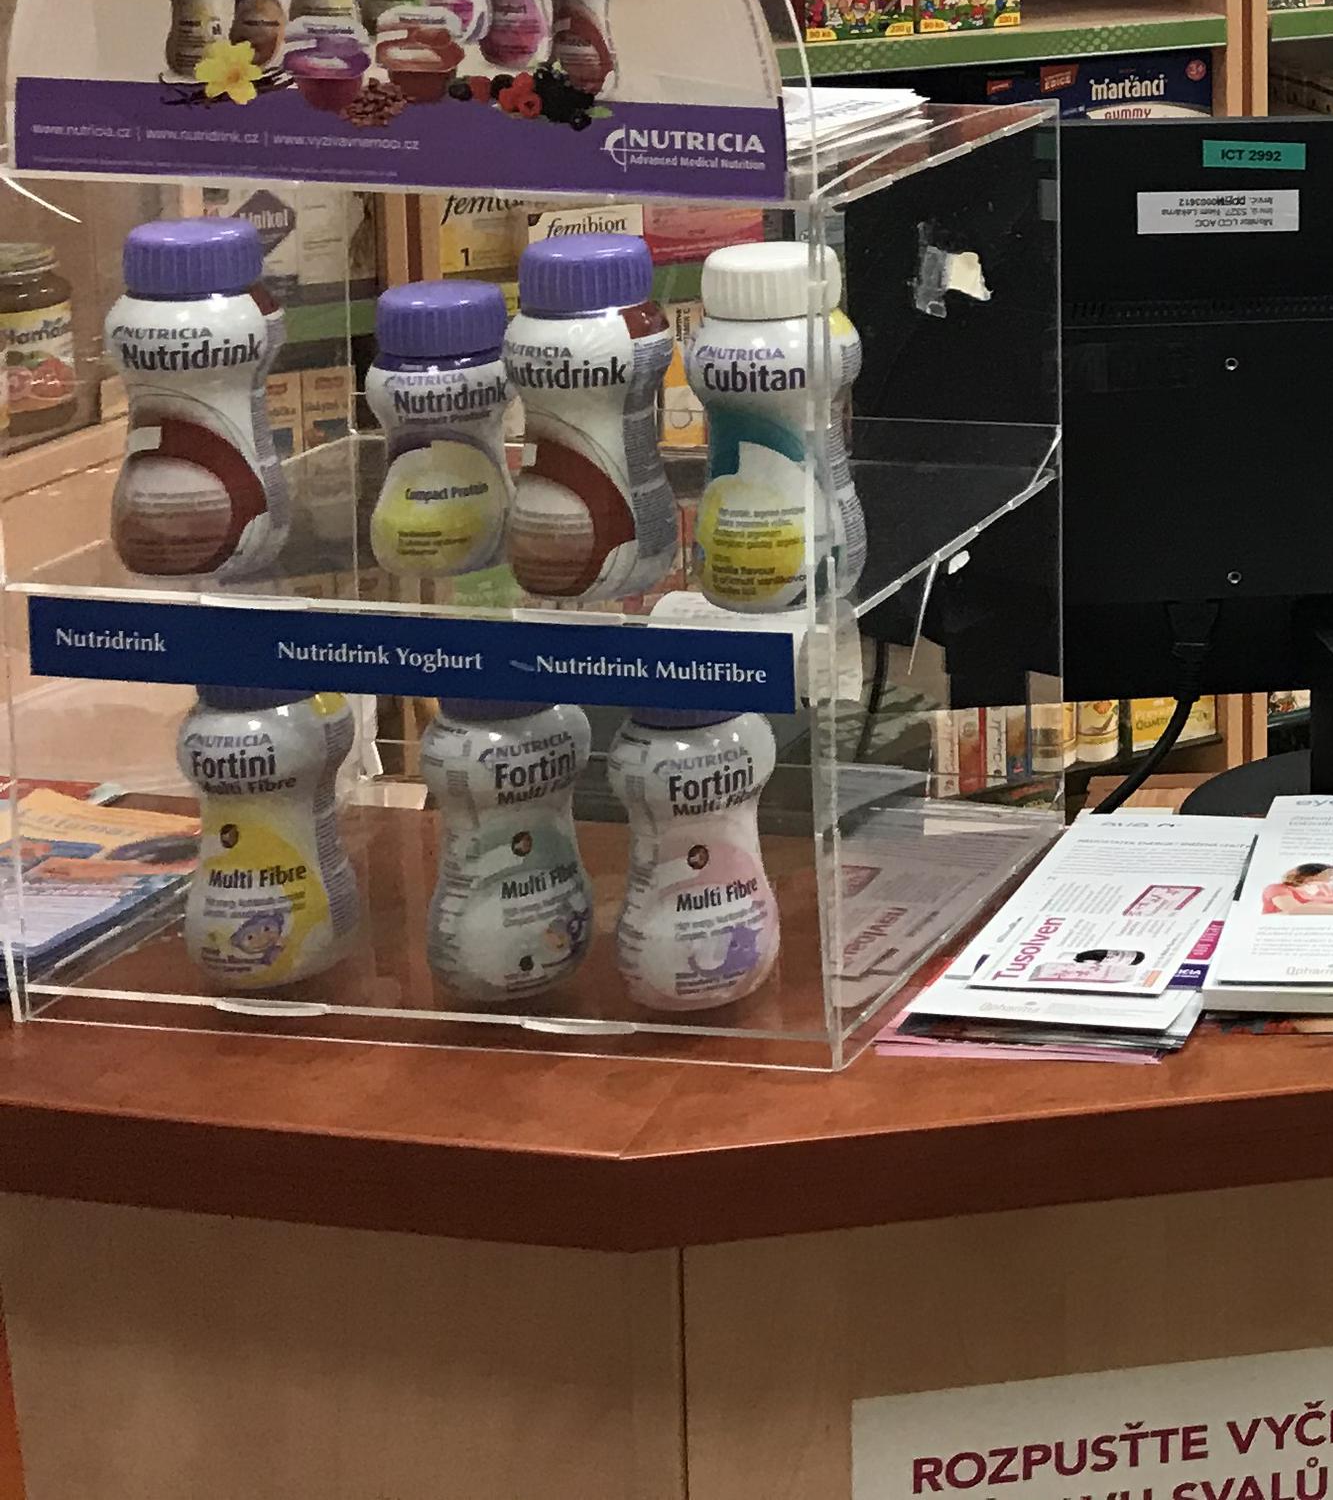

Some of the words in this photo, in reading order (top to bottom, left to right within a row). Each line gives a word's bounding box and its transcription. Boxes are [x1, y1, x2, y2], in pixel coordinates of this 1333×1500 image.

[1089, 74, 1166, 102] marťánci
[630, 129, 766, 153] NUTRICIA
[1220, 147, 1244, 163] ICT
[1248, 148, 1282, 164] 2992
[630, 154, 677, 167] Advanced
[680, 156, 718, 168] Medical
[546, 216, 628, 240] femibion
[122, 334, 262, 371] Nutridrink
[707, 345, 785, 361] NUTRICIA
[703, 361, 806, 393] Cubitan
[394, 375, 506, 414] Nutridrink
[56, 628, 167, 652] Nutridrink
[278, 641, 390, 665] Nutridrink
[396, 647, 484, 672] Yoghurt
[536, 656, 648, 679] Nutridrink
[656, 659, 768, 684] MultiFibre
[191, 746, 277, 779] Fortini
[494, 745, 576, 789] Fortini
[669, 757, 754, 803] Fortini
[209, 868, 253, 889] Multi
[501, 875, 546, 899] Multi
[677, 889, 722, 913] Multi
[725, 877, 758, 903] Fibre
[993, 917, 1067, 981] Tusolven
[912, 1420, 1211, 1494] ROZPUSŤTE
[1172, 1456, 1331, 1500] SVALŮ
